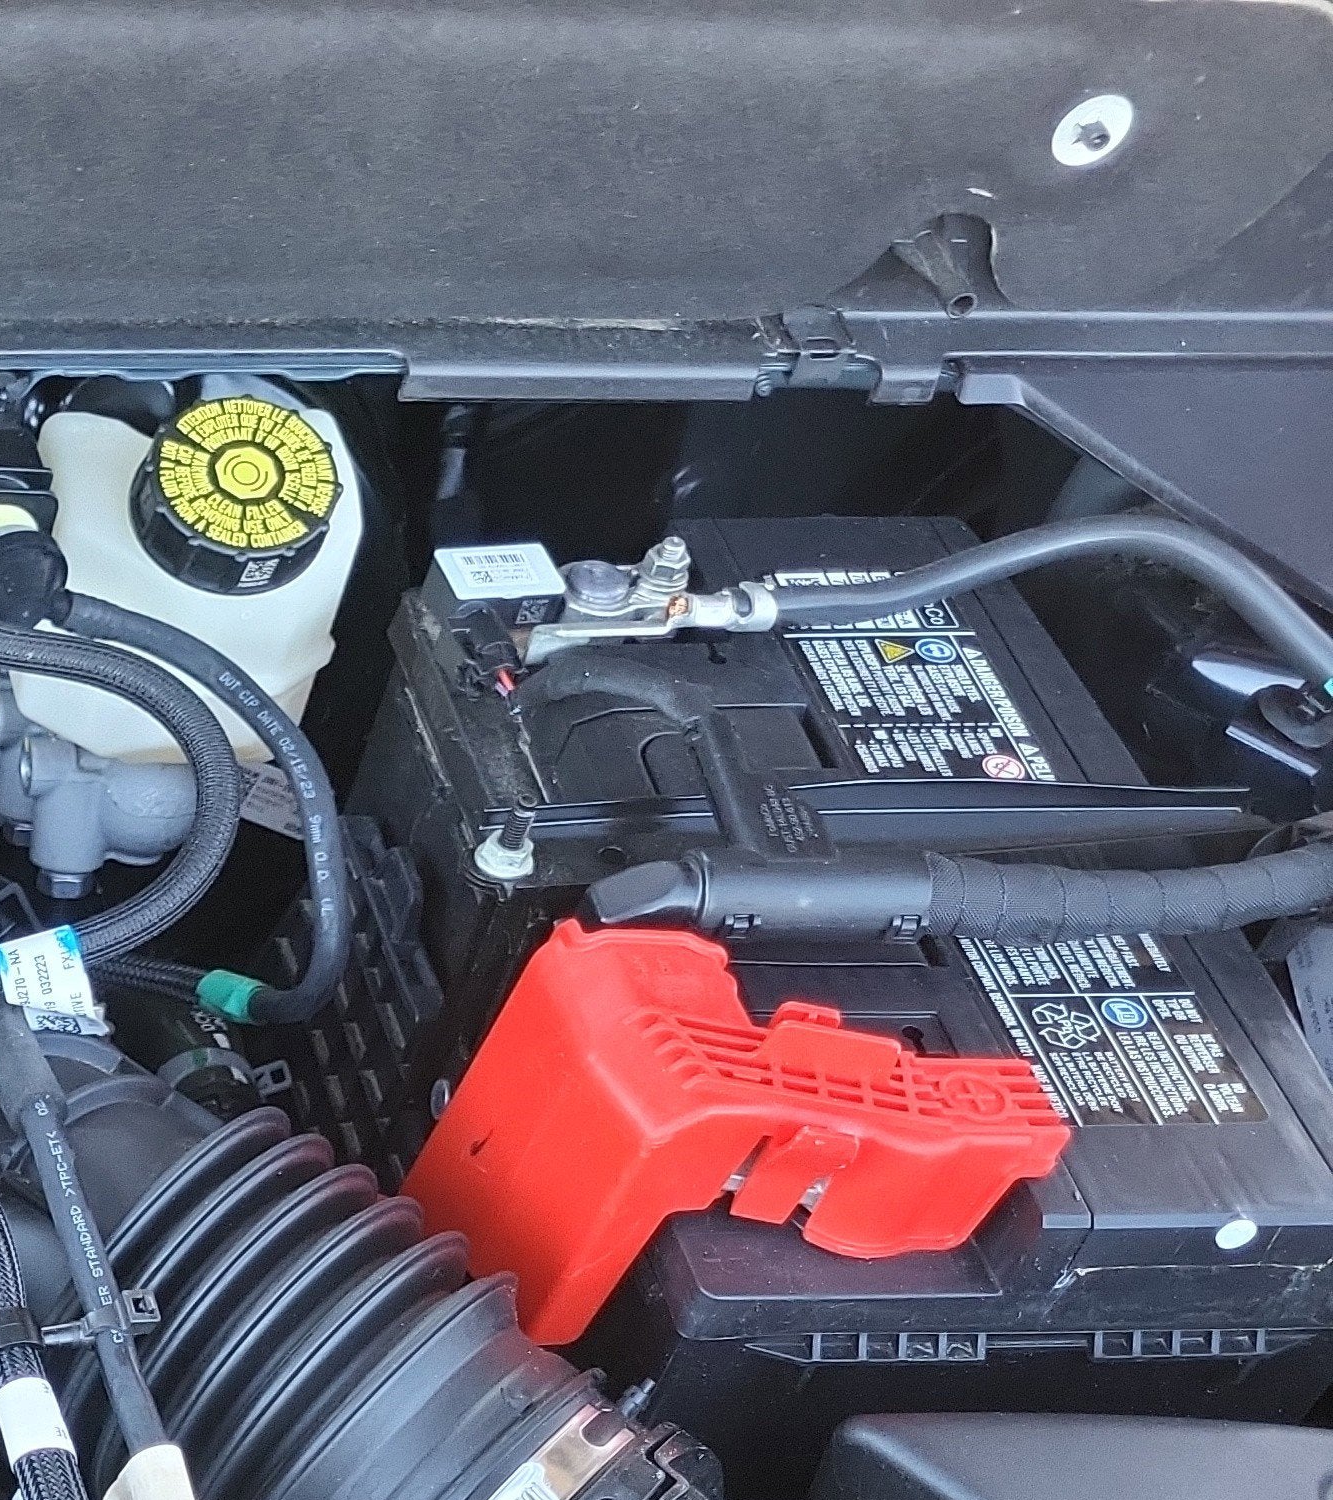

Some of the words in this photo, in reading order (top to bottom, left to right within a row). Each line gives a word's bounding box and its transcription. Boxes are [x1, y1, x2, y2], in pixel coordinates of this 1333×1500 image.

[222, 400, 273, 417] NETTOYER
[272, 408, 288, 423] LE
[239, 414, 258, 427] QUE
[259, 417, 273, 431] DU
[206, 493, 242, 519] CLEAN
[245, 499, 284, 520] FILLER
[193, 519, 207, 531] A
[206, 525, 247, 547] SEALED
[250, 519, 309, 547] CONTAINER
[243, 519, 264, 533] USE
[265, 513, 292, 531] ONLY
[967, 659, 1030, 737] DANGER/POISON
[32, 953, 54, 995] 032223
[1114, 1031, 1133, 1045] LEA
[1129, 1031, 1150, 1048] LIRE
[1144, 1031, 1166, 1050] READ
[1122, 1046, 1142, 1060] LAS
[1139, 1048, 1158, 1061] LES
[1205, 1043, 1224, 1057] PAS
[69, 1203, 104, 1278] STANDARD
[96, 1284, 125, 1344] CER
